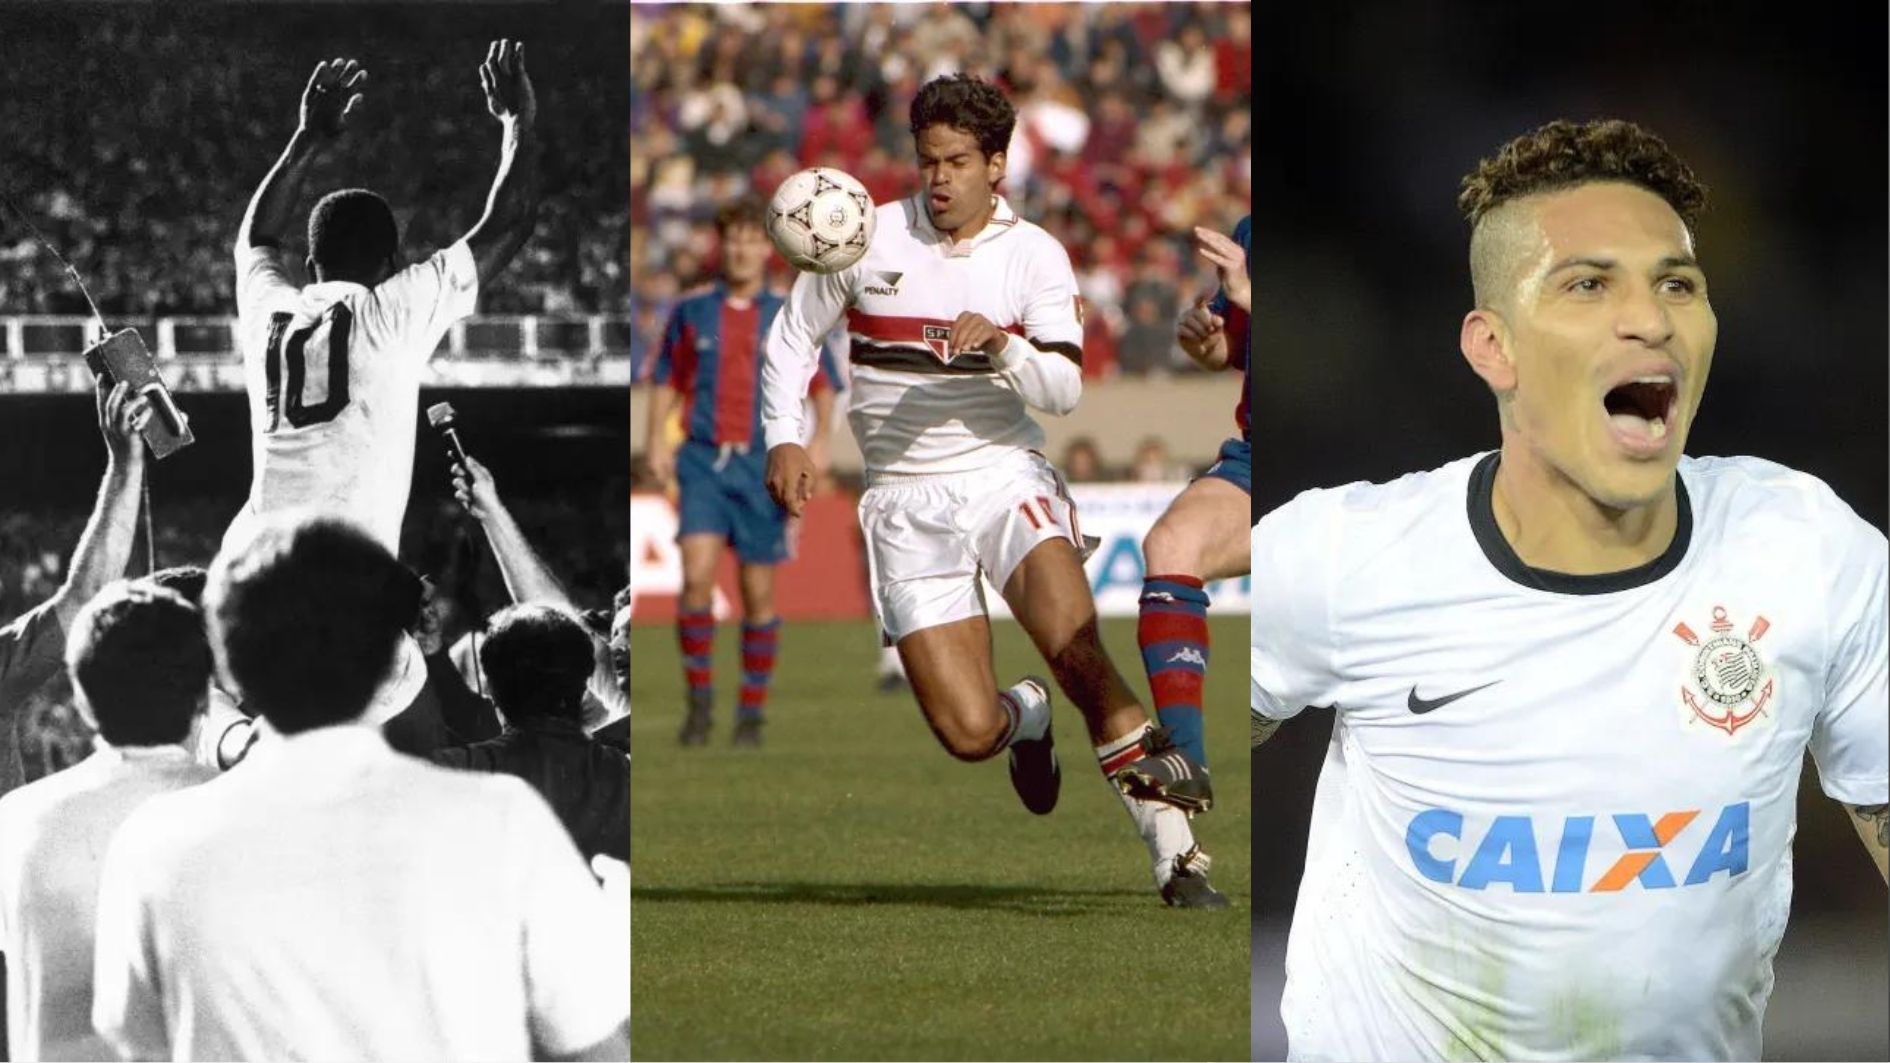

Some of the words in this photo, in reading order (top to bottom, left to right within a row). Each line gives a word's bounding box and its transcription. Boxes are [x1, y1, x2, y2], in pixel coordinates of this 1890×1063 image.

[864, 286, 899, 296] PENALTY
[264, 300, 352, 433] 10
[1404, 801, 1749, 893] CAIXA
